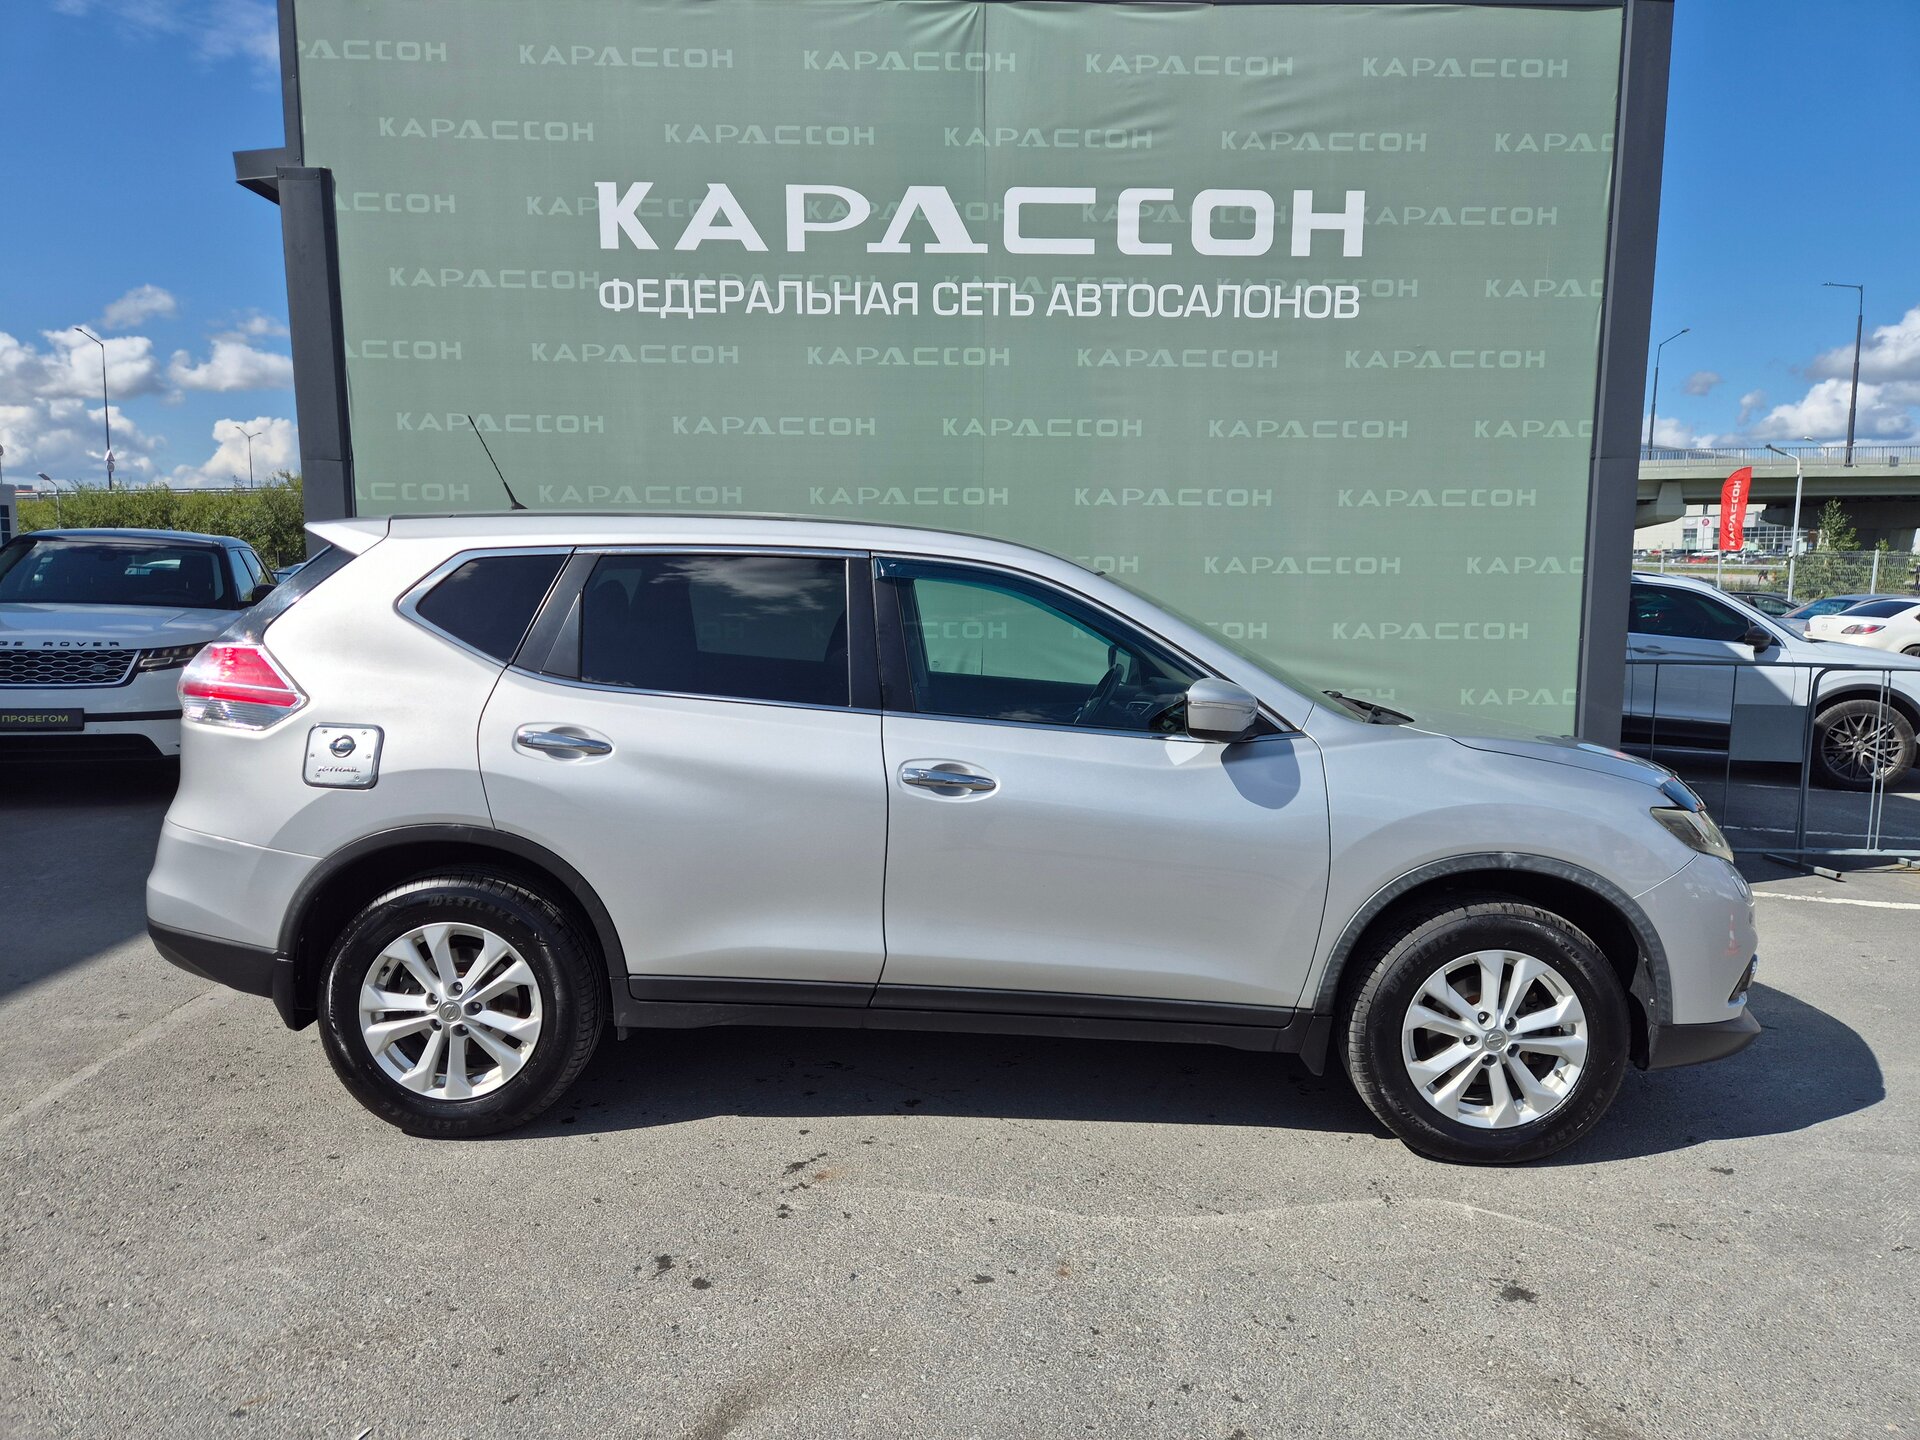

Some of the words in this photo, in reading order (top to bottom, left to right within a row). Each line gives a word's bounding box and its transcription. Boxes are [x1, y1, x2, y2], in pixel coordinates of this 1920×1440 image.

[518, 44, 733, 68] КАРЛССОН
[804, 50, 1016, 73] КАРЛССОН
[1086, 54, 1293, 76] КАРЛССОН
[1363, 58, 1567, 78] КАРЛССОН
[379, 117, 593, 141] КАРЛССОН
[665, 123, 874, 146] КАРЛССОН
[945, 127, 1152, 149] КАРЛССОН
[1222, 132, 1427, 152] КАРЛССОН
[594, 181, 1365, 257] КАРЛССОН
[1363, 207, 1557, 226] АРЛССОН
[390, 267, 598, 290] КАРЛССОН
[599, 278, 919, 319] ФЕДЕРАЛЬНАЯ
[932, 281, 1035, 317] СЕТЬ
[1046, 283, 1361, 319] АВТОСАЛОНОВ
[532, 343, 738, 364] КАРЛССОН
[807, 346, 1009, 366] КАРЛССОН
[1077, 349, 1278, 368] КАРЛССОН
[1345, 350, 1545, 368] КАРЛССОН
[396, 412, 604, 433] КАРЛССОН
[672, 416, 875, 435] КАРЛССОН
[943, 418, 1142, 437] КАРЛССОН
[1208, 420, 1407, 438] КАРЛССОН
[538, 485, 742, 505] КАРЛССОН
[809, 486, 1008, 505] КАРЛССОН
[1075, 488, 1272, 506] КАРЛССОН
[1338, 489, 1536, 506] КАРЛССОН
[1204, 557, 1400, 574] КАРЛССОН
[1332, 623, 1528, 639] КАРЛССОН
[2, 714, 69, 723] ПРОБЕГОМ
